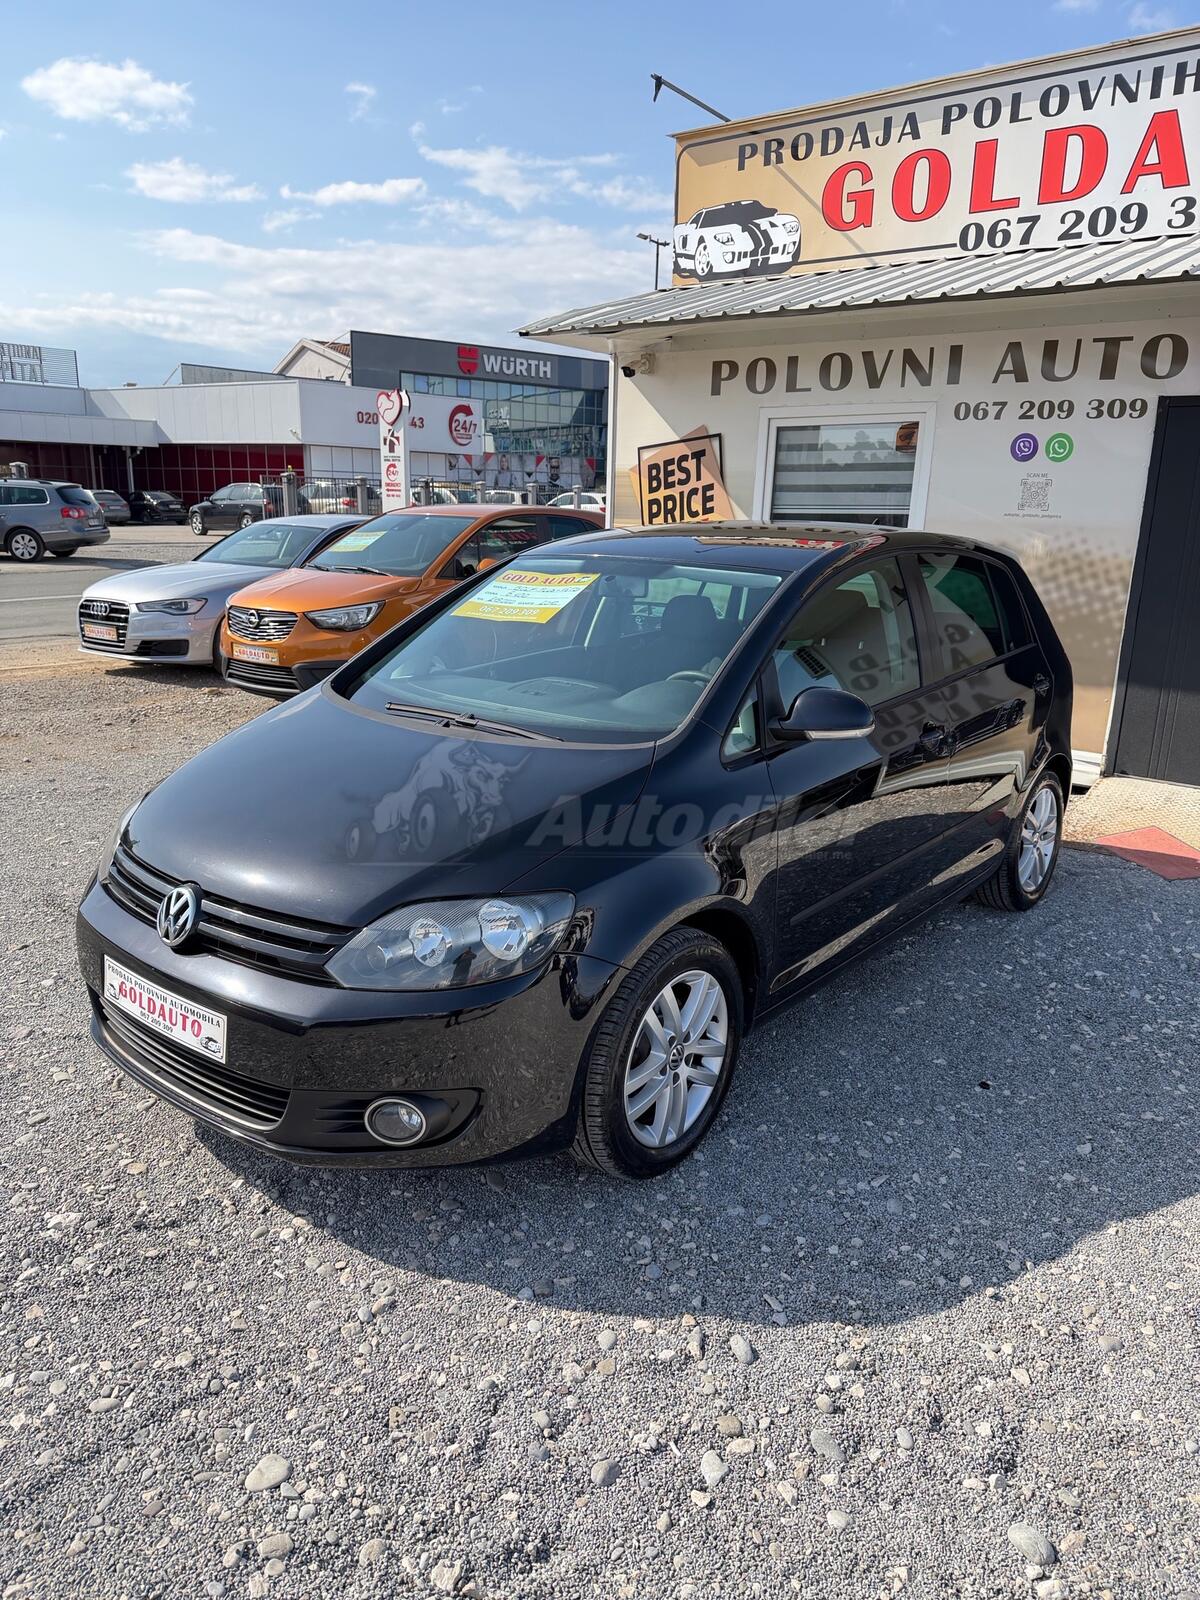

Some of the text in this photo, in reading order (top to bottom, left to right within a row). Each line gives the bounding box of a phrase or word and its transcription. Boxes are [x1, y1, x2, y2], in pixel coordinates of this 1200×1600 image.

[737, 58, 1200, 172] PRODAJA POLOVNIH
[821, 109, 1191, 232] GOLDA
[958, 195, 1197, 252] 067 209 3
[483, 354, 551, 379] WÜRTH
[710, 333, 1190, 396] POLOVNI AUTO
[453, 418, 477, 434] 24/7
[953, 398, 1149, 422] 067 209 309
[647, 448, 706, 494] BEST
[647, 483, 715, 524] PRICE
[502, 573, 576, 585] GOLD AUTO
[119, 980, 202, 1038] GOLDAUTO
[134, 980, 168, 1005] POLOVNIH
[170, 1000, 221, 1029] AUTOMOBILA
